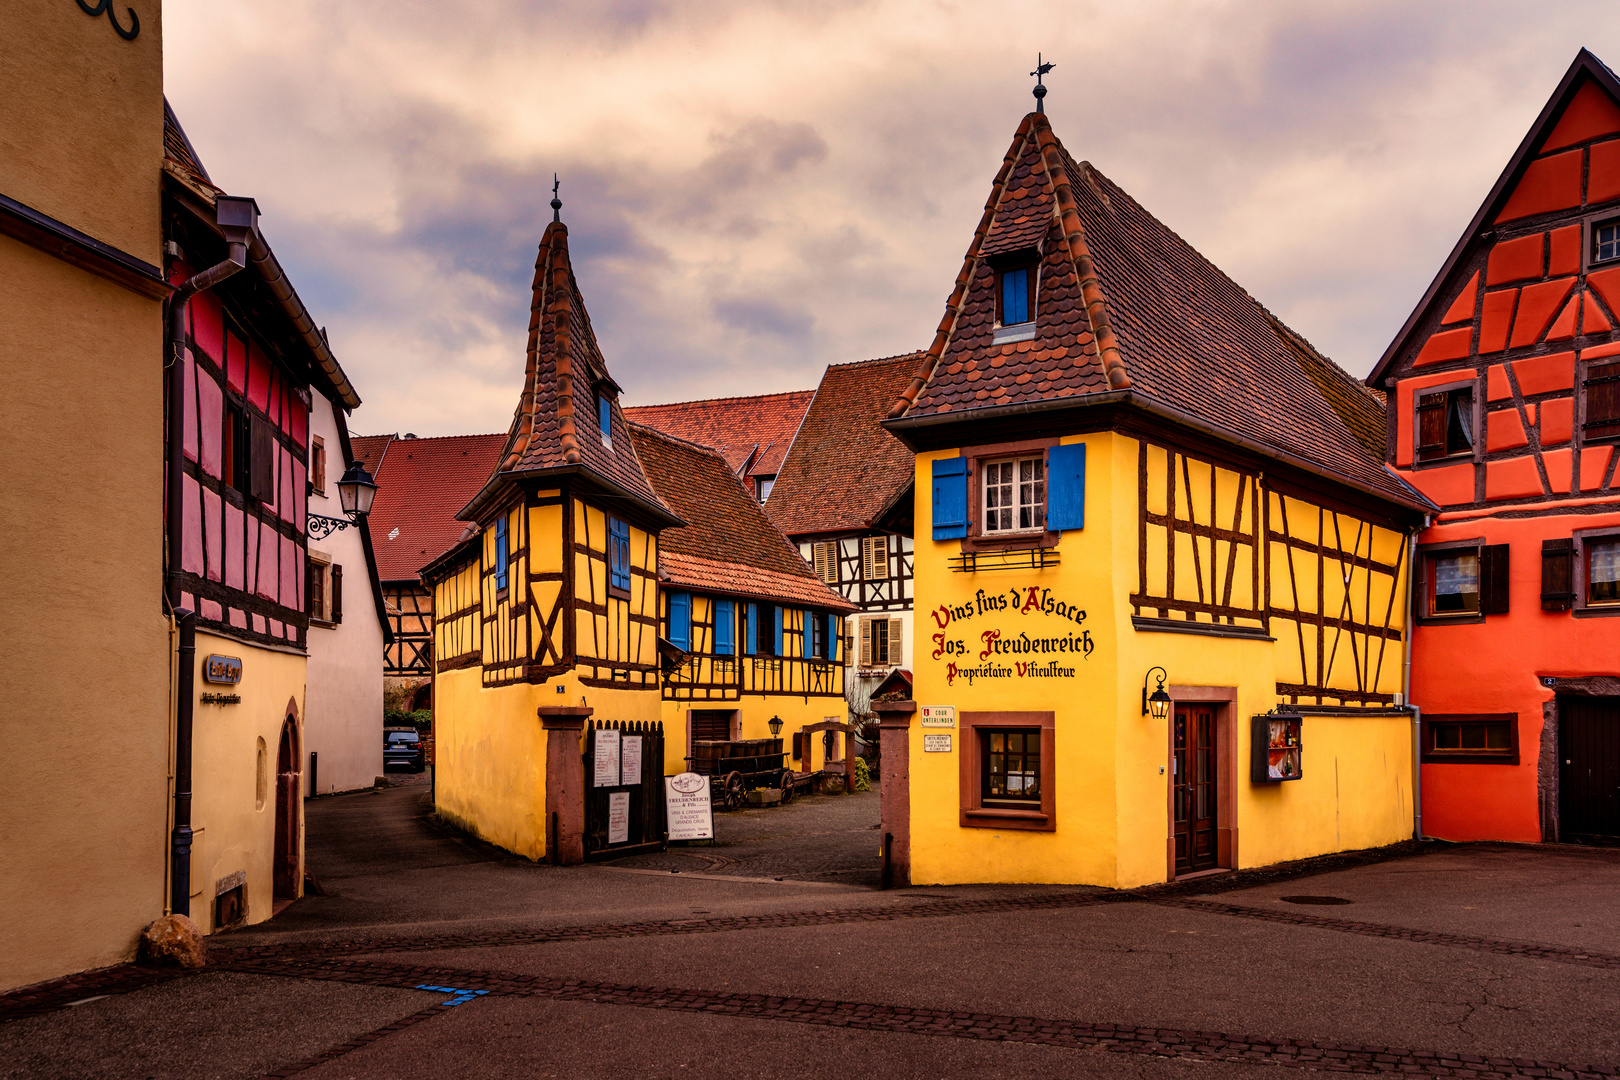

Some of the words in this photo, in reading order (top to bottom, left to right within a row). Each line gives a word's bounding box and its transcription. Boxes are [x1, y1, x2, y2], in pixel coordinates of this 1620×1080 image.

[930, 601, 974, 629] Vins
[975, 588, 1007, 616] fins
[1009, 585, 1087, 625] d'Alsace
[932, 631, 970, 660] Jos.
[979, 628, 1094, 661] Freudenreich
[946, 661, 1012, 686] Propriétaire
[1015, 660, 1075, 678] Viticulteur
